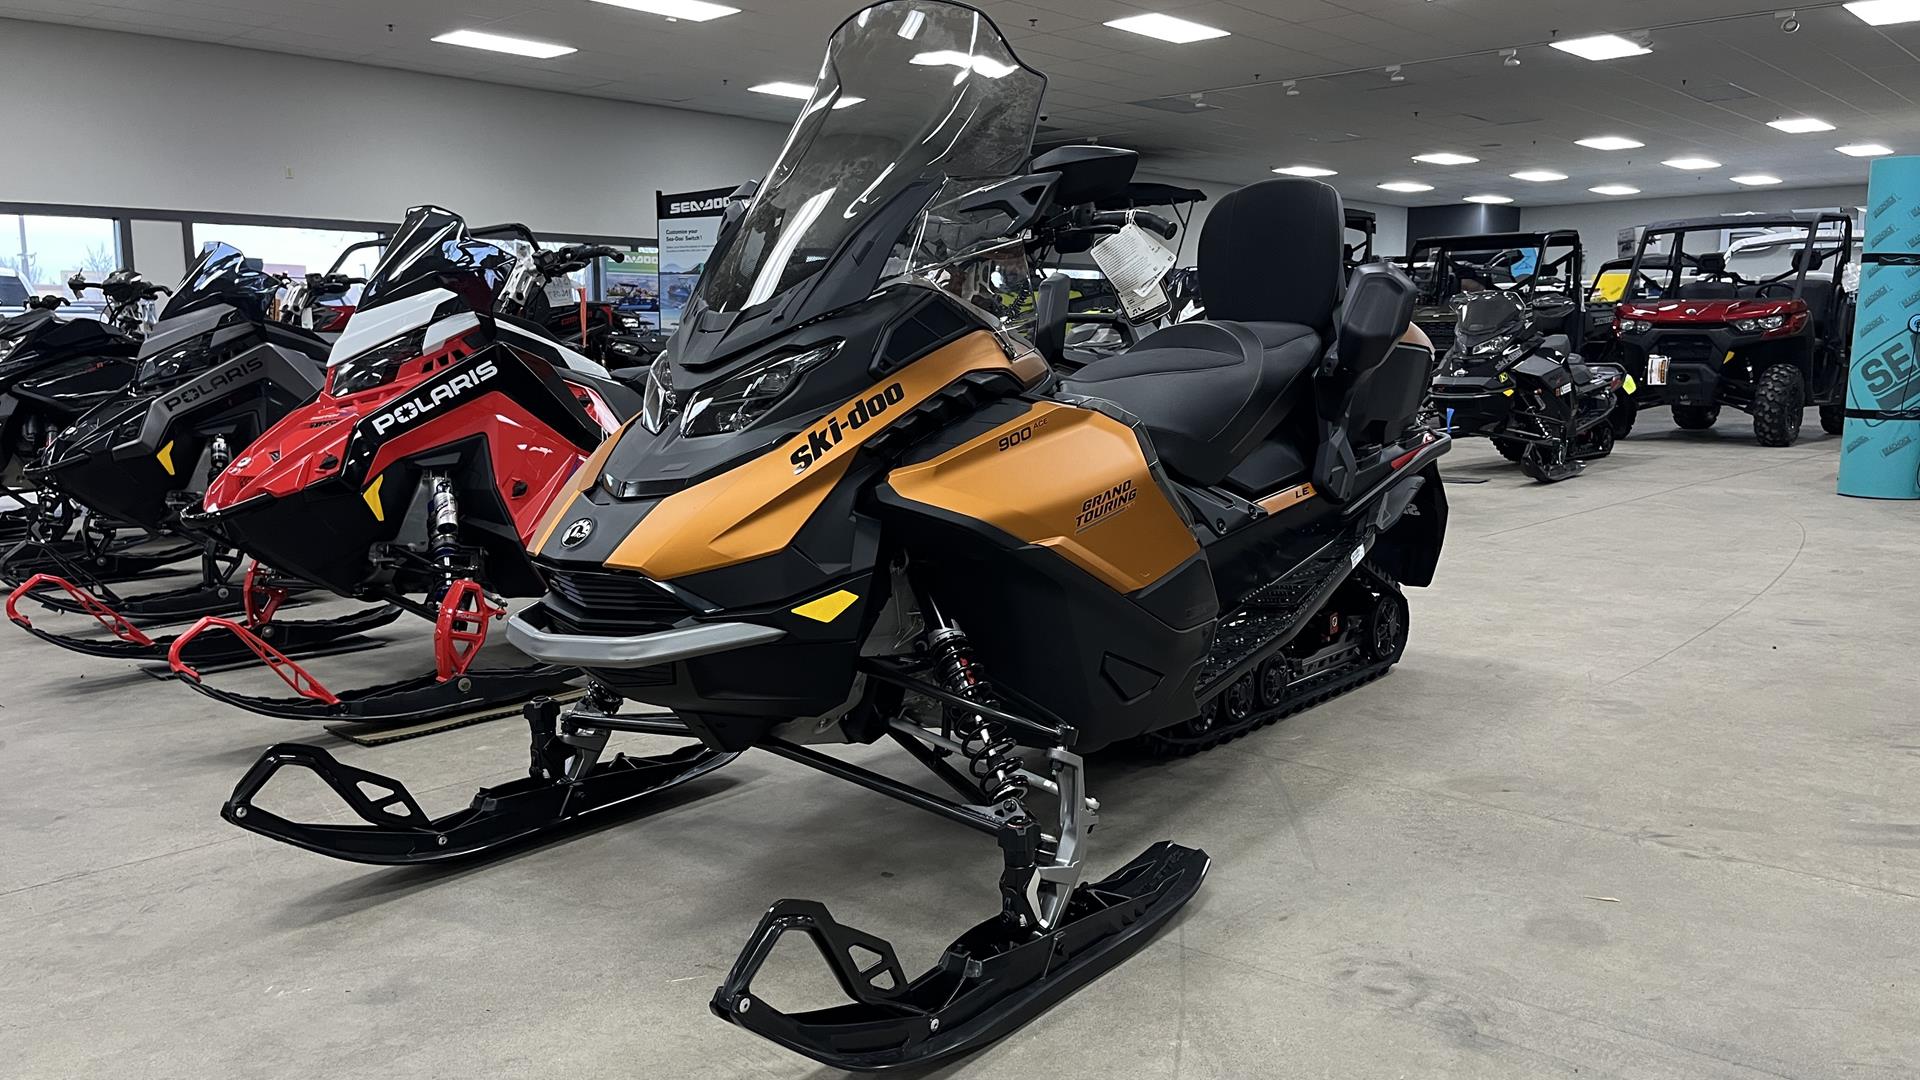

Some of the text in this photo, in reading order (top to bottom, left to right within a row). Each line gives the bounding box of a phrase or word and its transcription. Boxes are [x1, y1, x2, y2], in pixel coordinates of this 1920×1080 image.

[163, 357, 264, 412] POLARIS
[371, 360, 498, 436] POLARIS
[998, 418, 1048, 451] 900 ACE
[1076, 488, 1137, 527] TOURING
[1082, 480, 1132, 513] GRAND
[1295, 486, 1309, 498] LE
